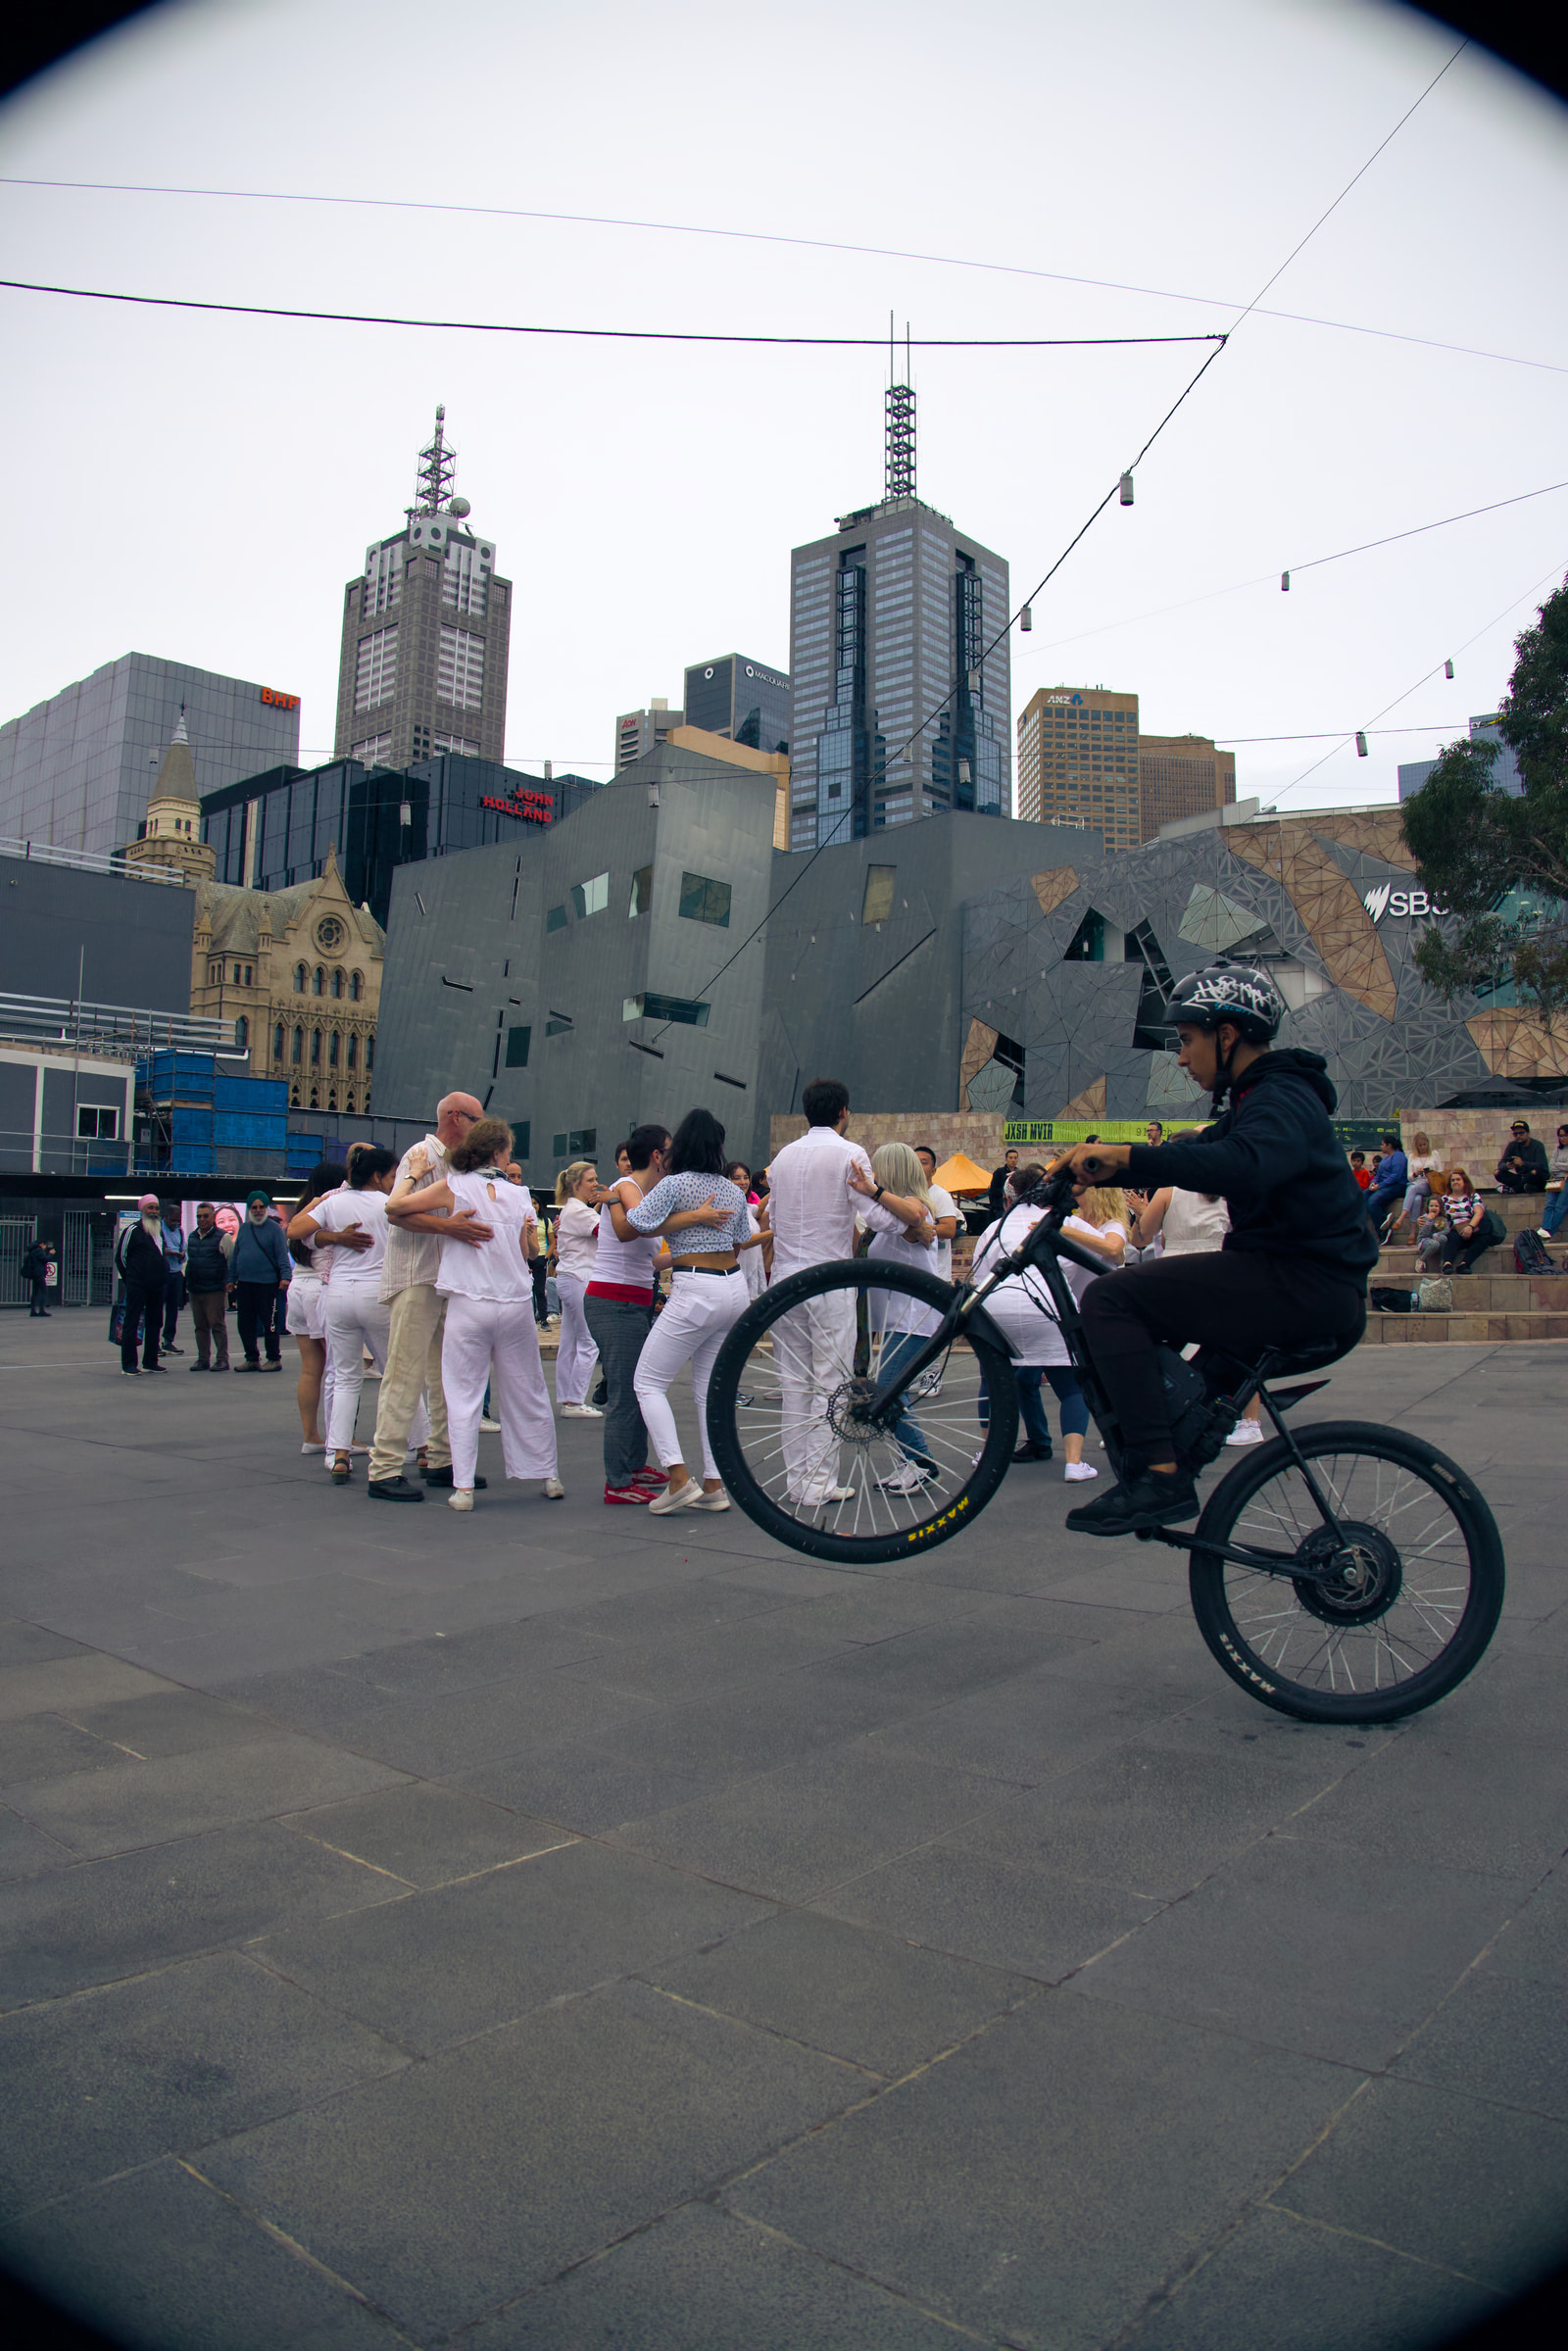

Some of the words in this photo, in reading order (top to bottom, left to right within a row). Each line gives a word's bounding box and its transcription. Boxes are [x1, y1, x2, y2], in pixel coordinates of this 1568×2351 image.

[261, 686, 300, 710] BHP
[1046, 695, 1070, 705] ANZ
[483, 795, 553, 823] HOLLAND
[514, 787, 554, 807] JOHN
[1004, 1123, 1028, 1140] JXSH
[1030, 1123, 1054, 1140] MVIR
[907, 1495, 969, 1542] MAXXIS
[1218, 1633, 1276, 1694] MAXXIS
